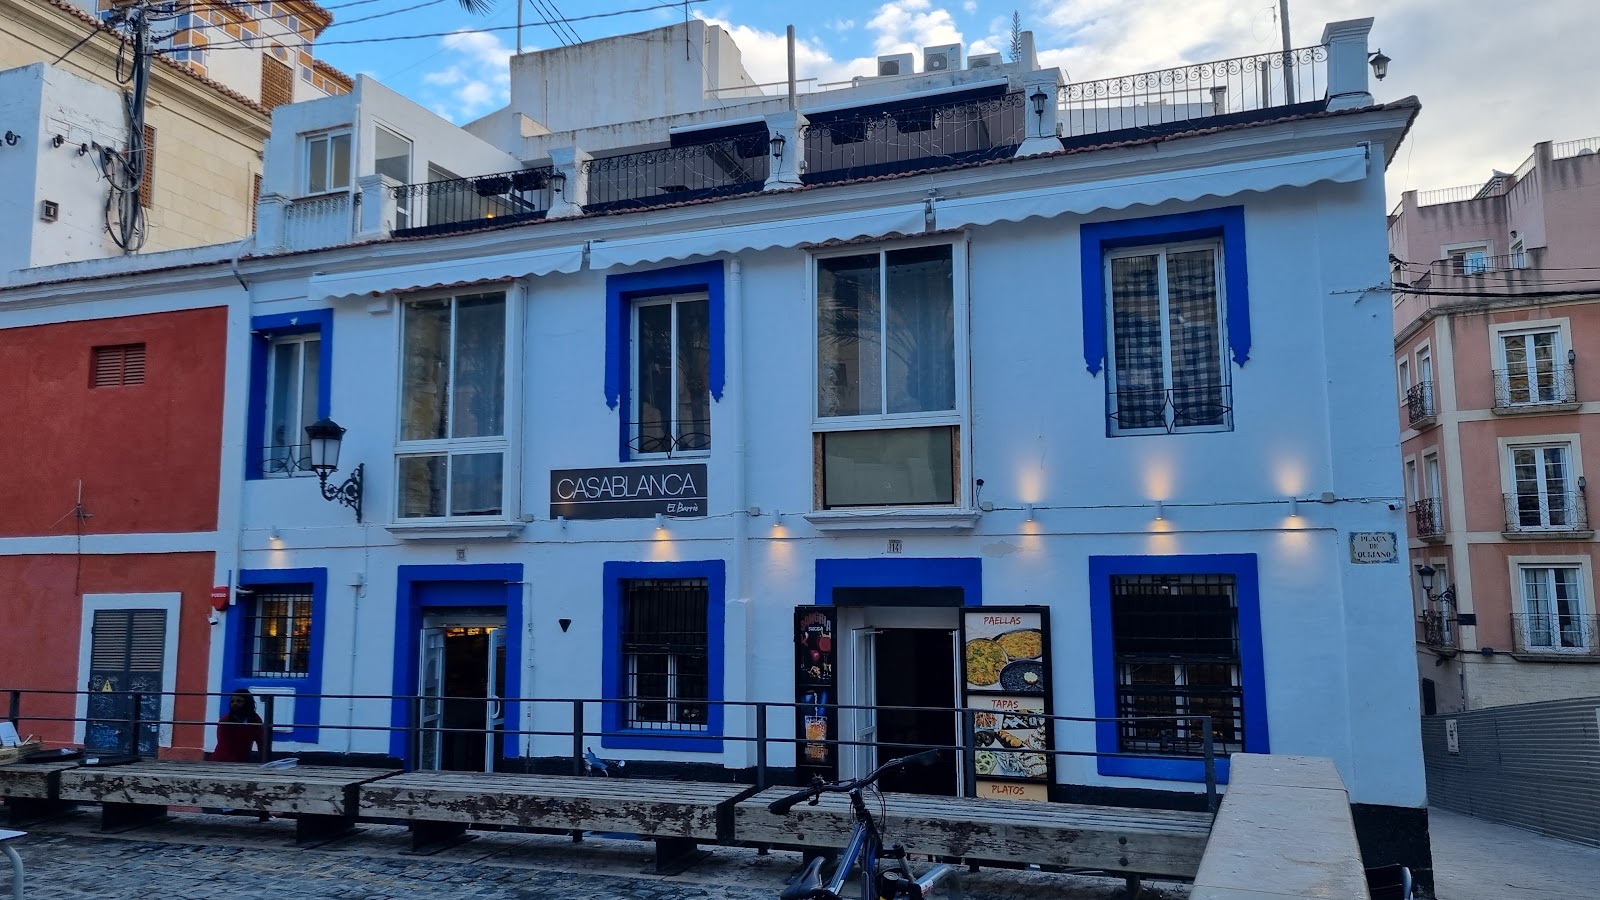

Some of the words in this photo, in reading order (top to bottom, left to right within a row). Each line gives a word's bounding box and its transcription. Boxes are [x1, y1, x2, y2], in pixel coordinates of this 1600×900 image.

[557, 473, 697, 500] CASABLANCA
[666, 503, 676, 513] El
[983, 616, 1021, 625] PAELLAS
[991, 699, 1019, 709] TAPAS
[991, 784, 1025, 795] PLATOS
